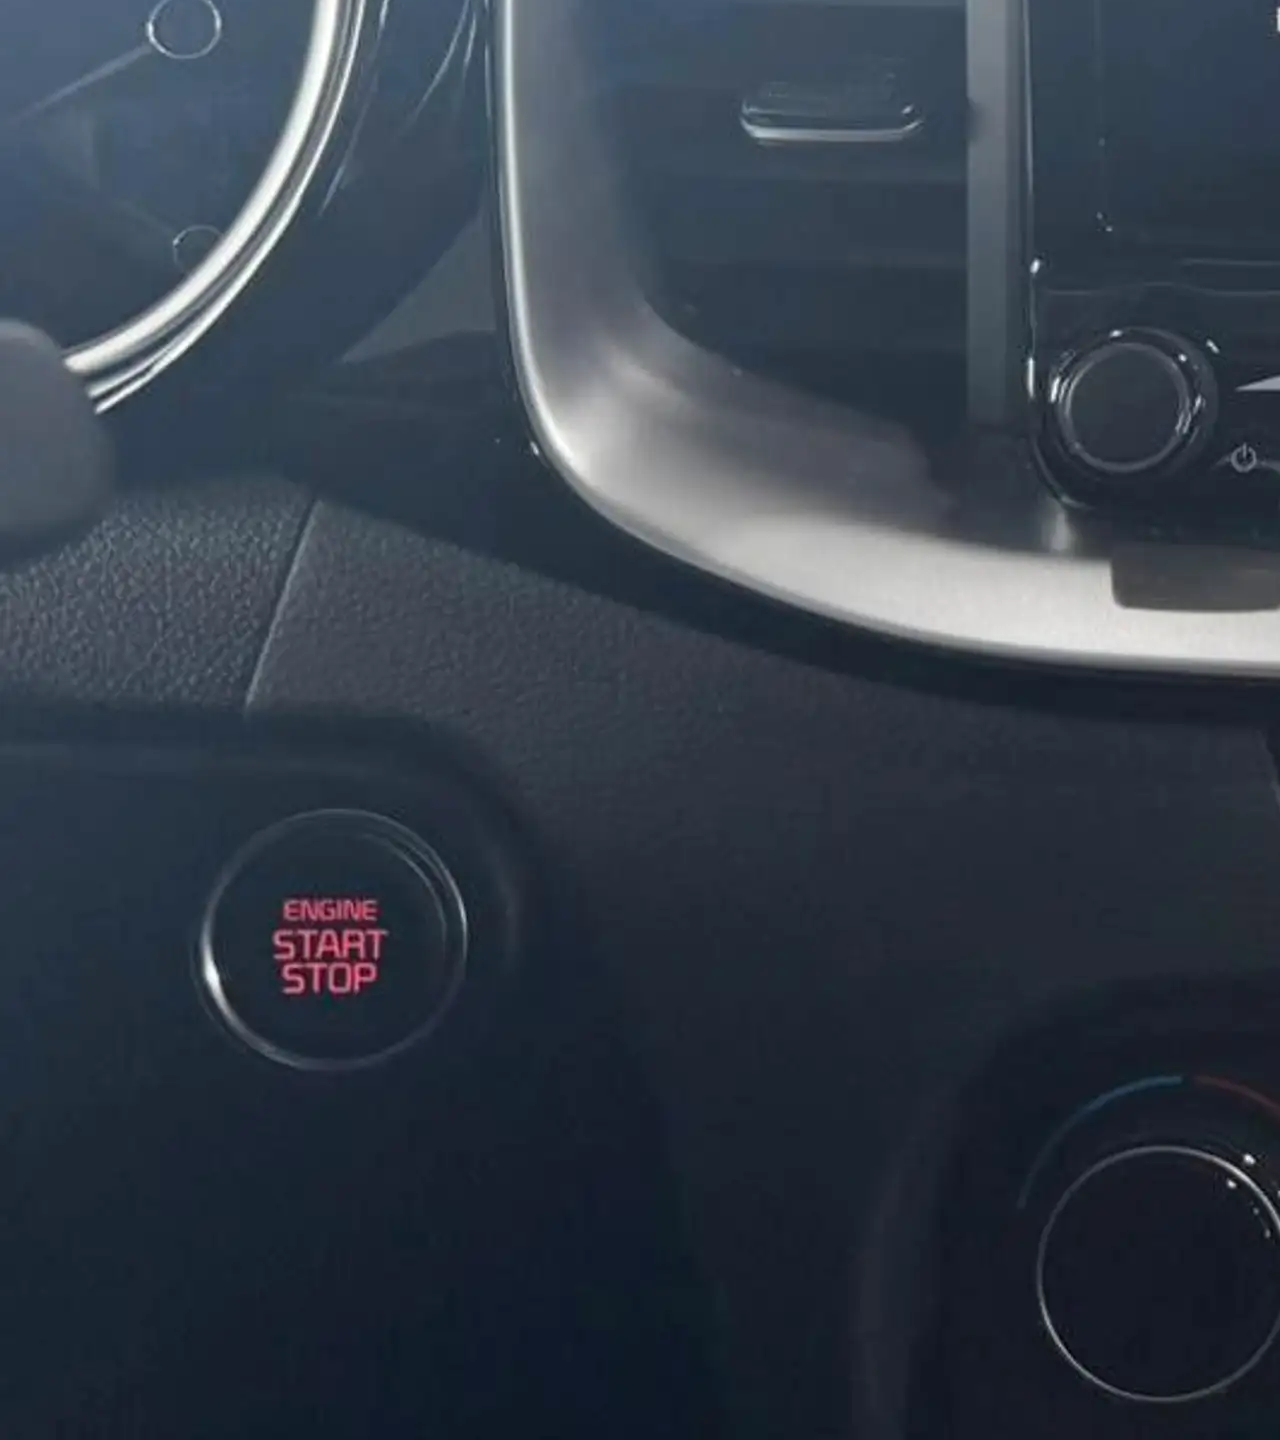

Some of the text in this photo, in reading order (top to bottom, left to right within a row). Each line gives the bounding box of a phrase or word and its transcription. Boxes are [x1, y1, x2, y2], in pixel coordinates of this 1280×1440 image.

[284, 900, 376, 921] ENGINE
[272, 928, 389, 960] START
[282, 962, 377, 993] STOP
